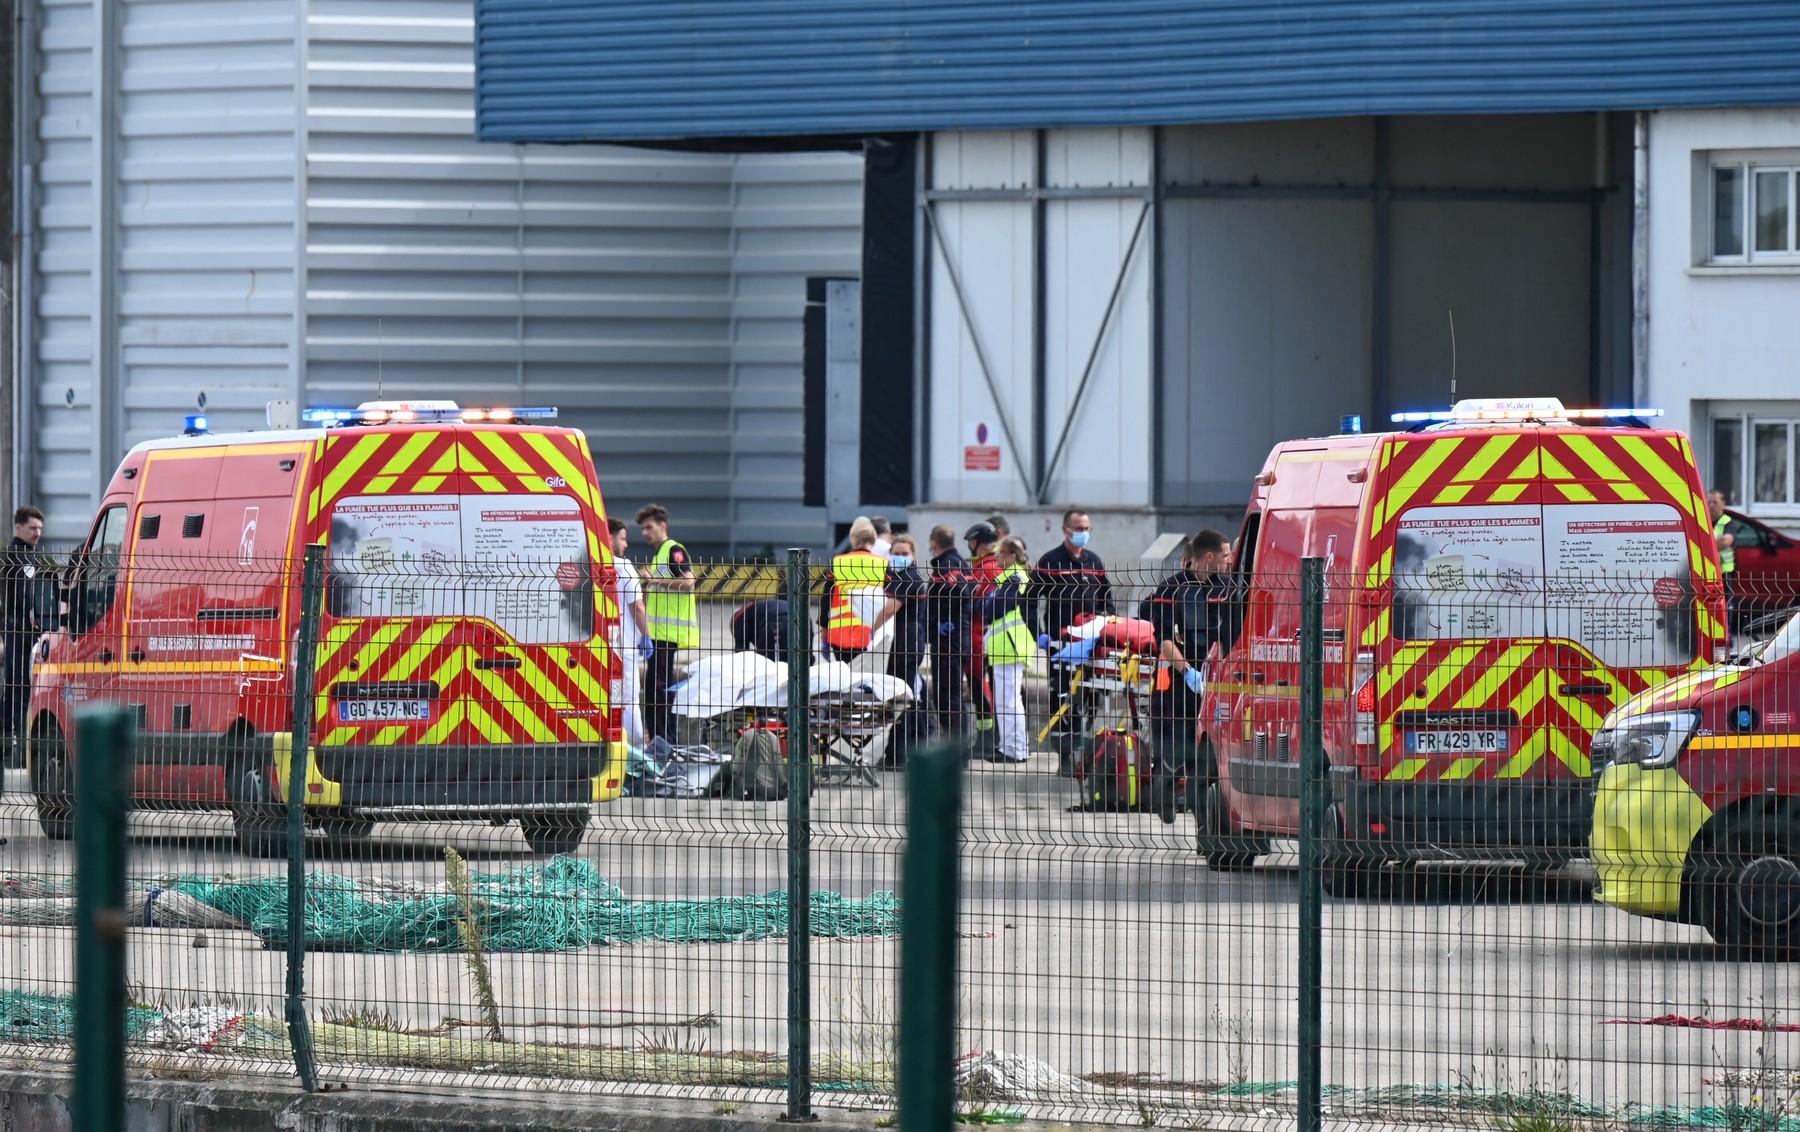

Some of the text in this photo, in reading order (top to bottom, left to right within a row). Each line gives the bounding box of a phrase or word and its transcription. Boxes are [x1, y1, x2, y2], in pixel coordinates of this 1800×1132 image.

[350, 702, 418, 716] GD-457-NG
[1427, 717, 1486, 725] MASTER
[1418, 732, 1494, 749] FR-429-YR
